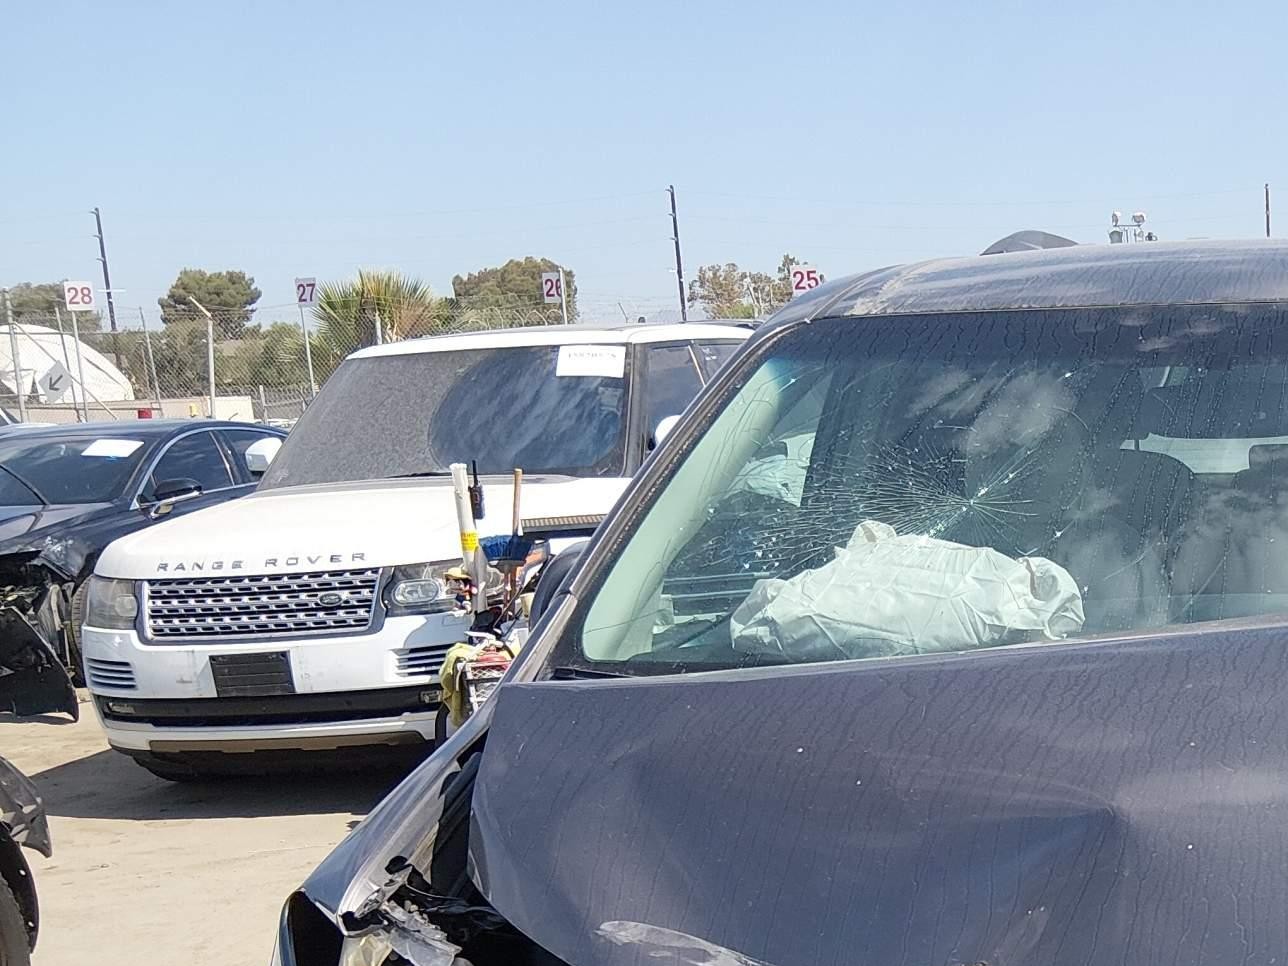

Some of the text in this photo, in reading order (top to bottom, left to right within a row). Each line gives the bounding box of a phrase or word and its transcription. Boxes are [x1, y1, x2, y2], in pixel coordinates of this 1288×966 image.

[792, 270, 819, 290] 25
[67, 286, 93, 305] 28
[297, 283, 316, 302] 27
[156, 552, 366, 572] RANGE ROVER
